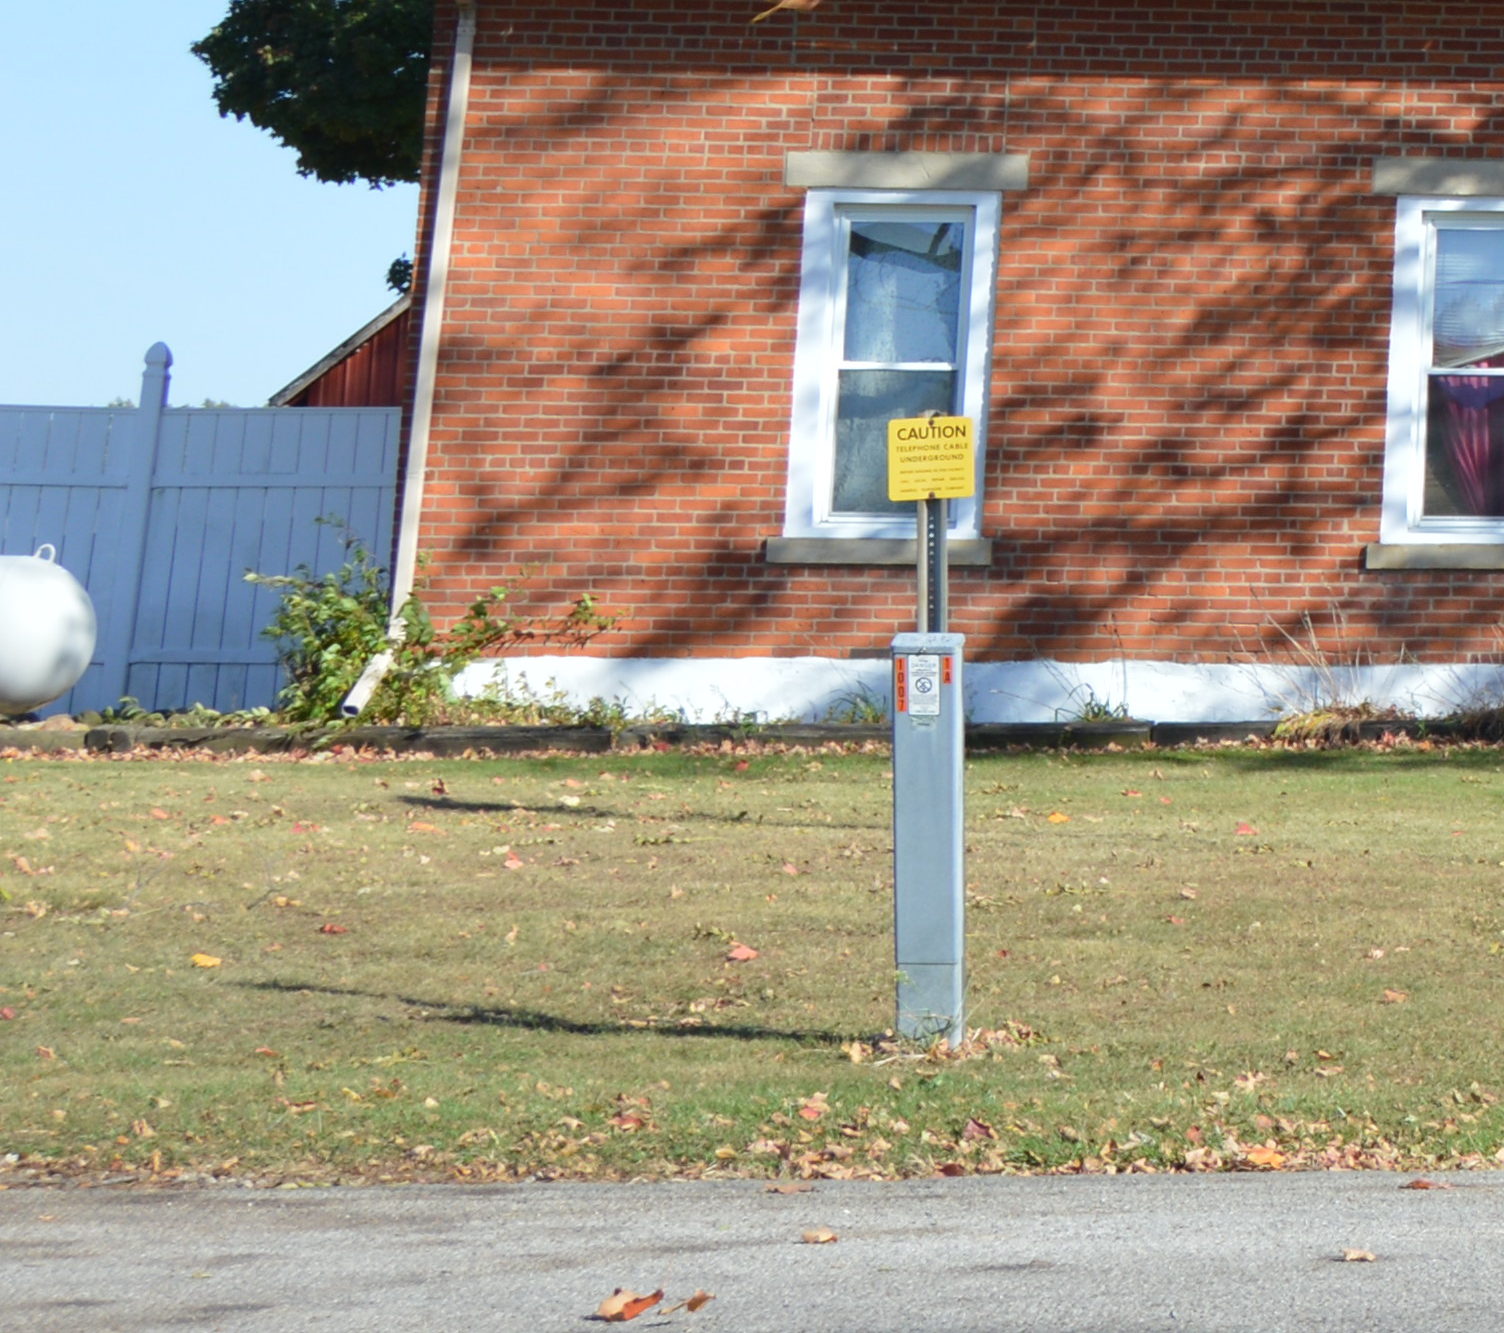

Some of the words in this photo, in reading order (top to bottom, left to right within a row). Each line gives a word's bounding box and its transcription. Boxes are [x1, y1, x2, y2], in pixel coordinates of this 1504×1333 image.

[897, 425, 967, 441] CAUTION
[896, 444, 940, 453] TELEPHONE
[943, 443, 968, 451] CABLE
[900, 453, 964, 463] UNDERGROUND
